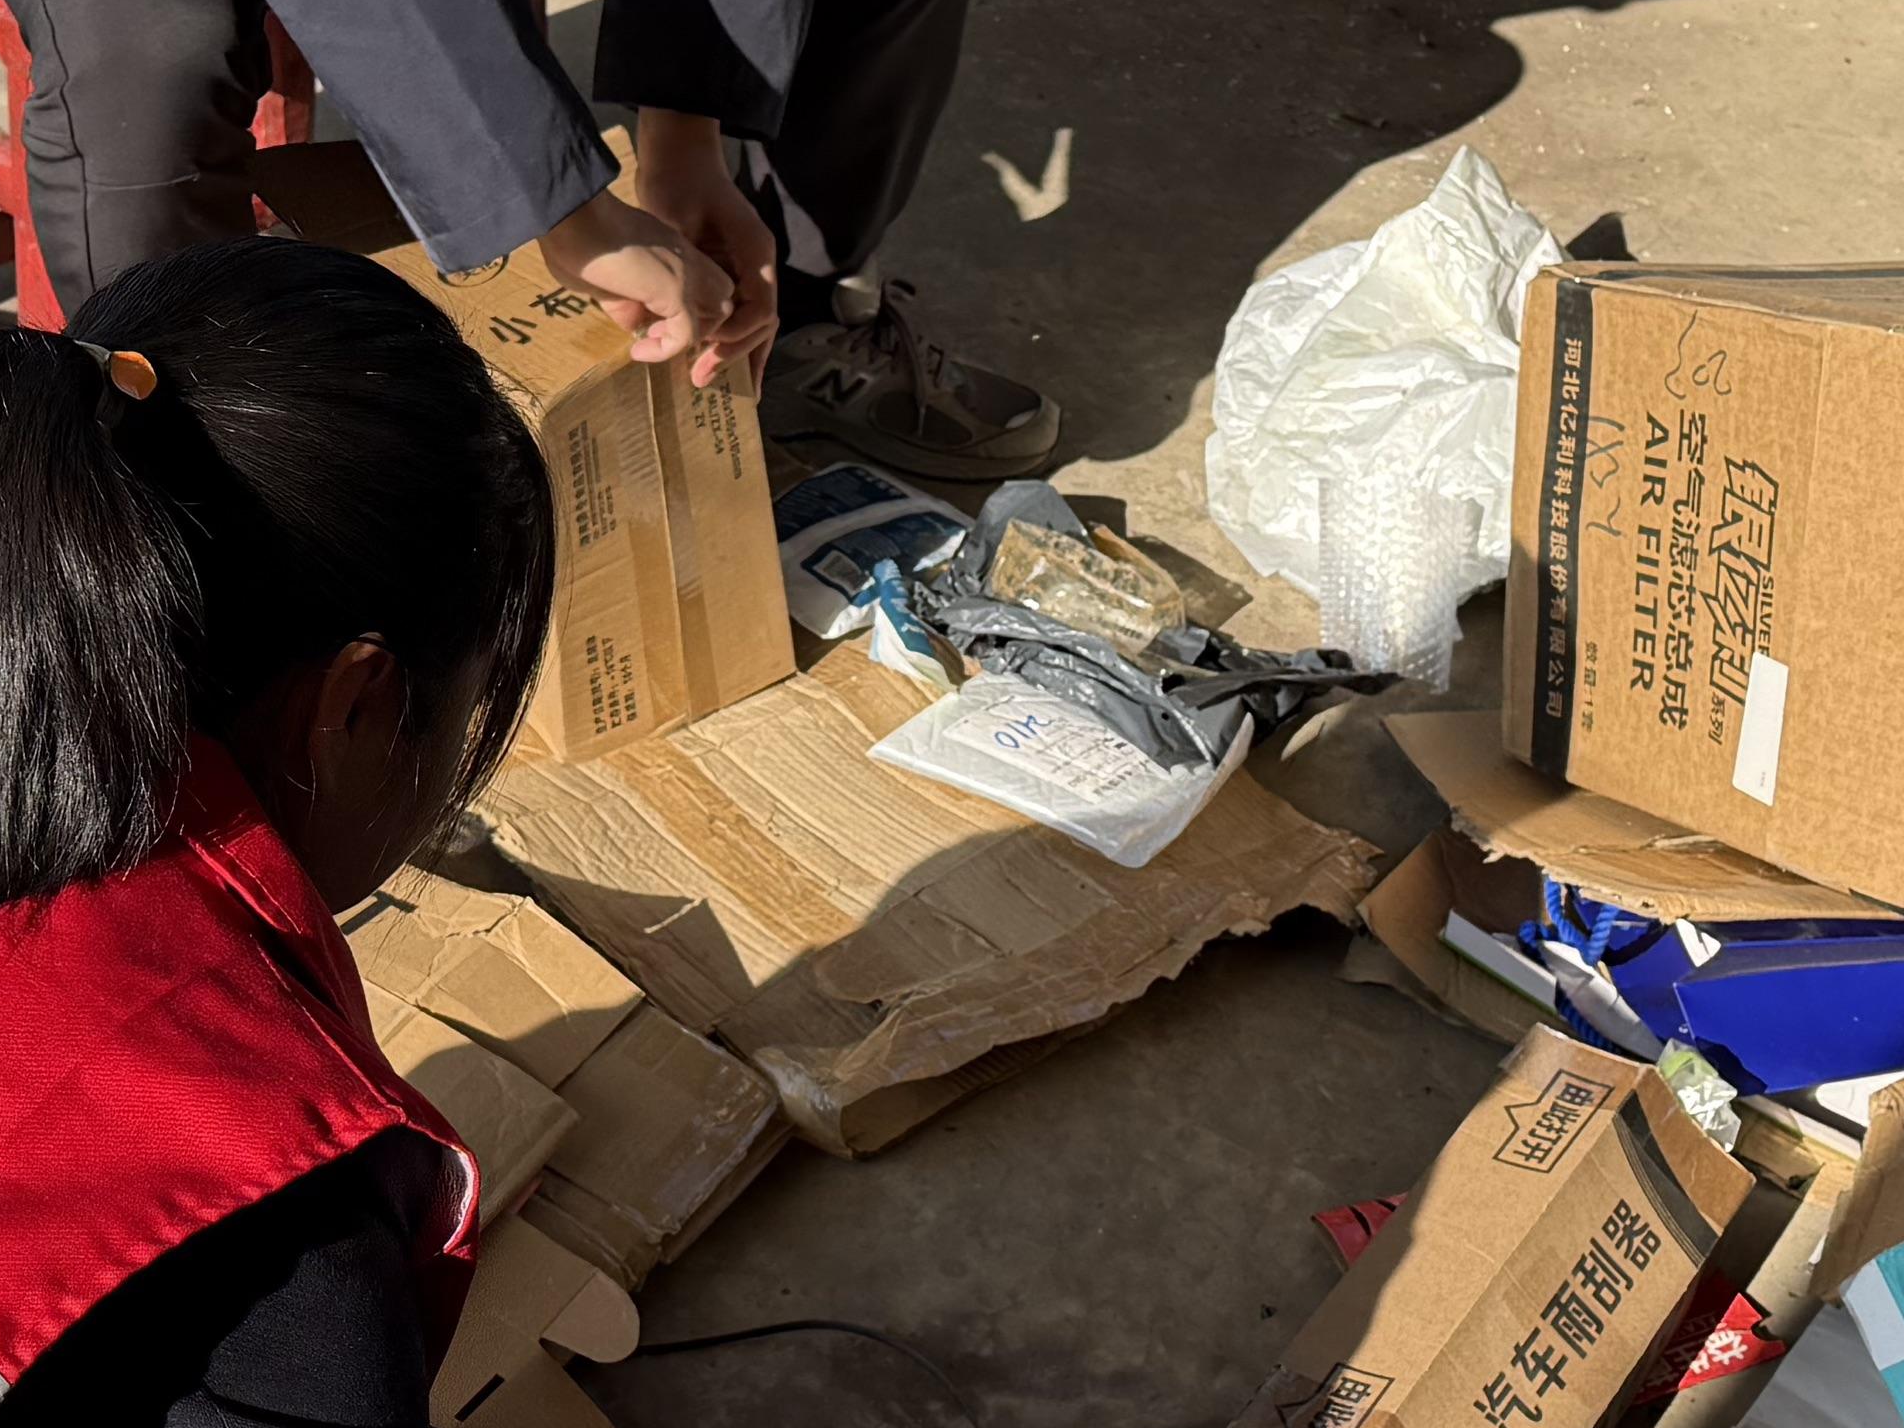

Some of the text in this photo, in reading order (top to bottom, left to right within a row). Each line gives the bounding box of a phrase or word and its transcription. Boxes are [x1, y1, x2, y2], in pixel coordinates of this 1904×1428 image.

[490, 282, 604, 345] 小布
[1544, 336, 1585, 722] 河北亿利科技股份有限公司
[1628, 412, 1670, 694] AIR FILTER
[1657, 407, 1710, 732] 空气滤芯总成
